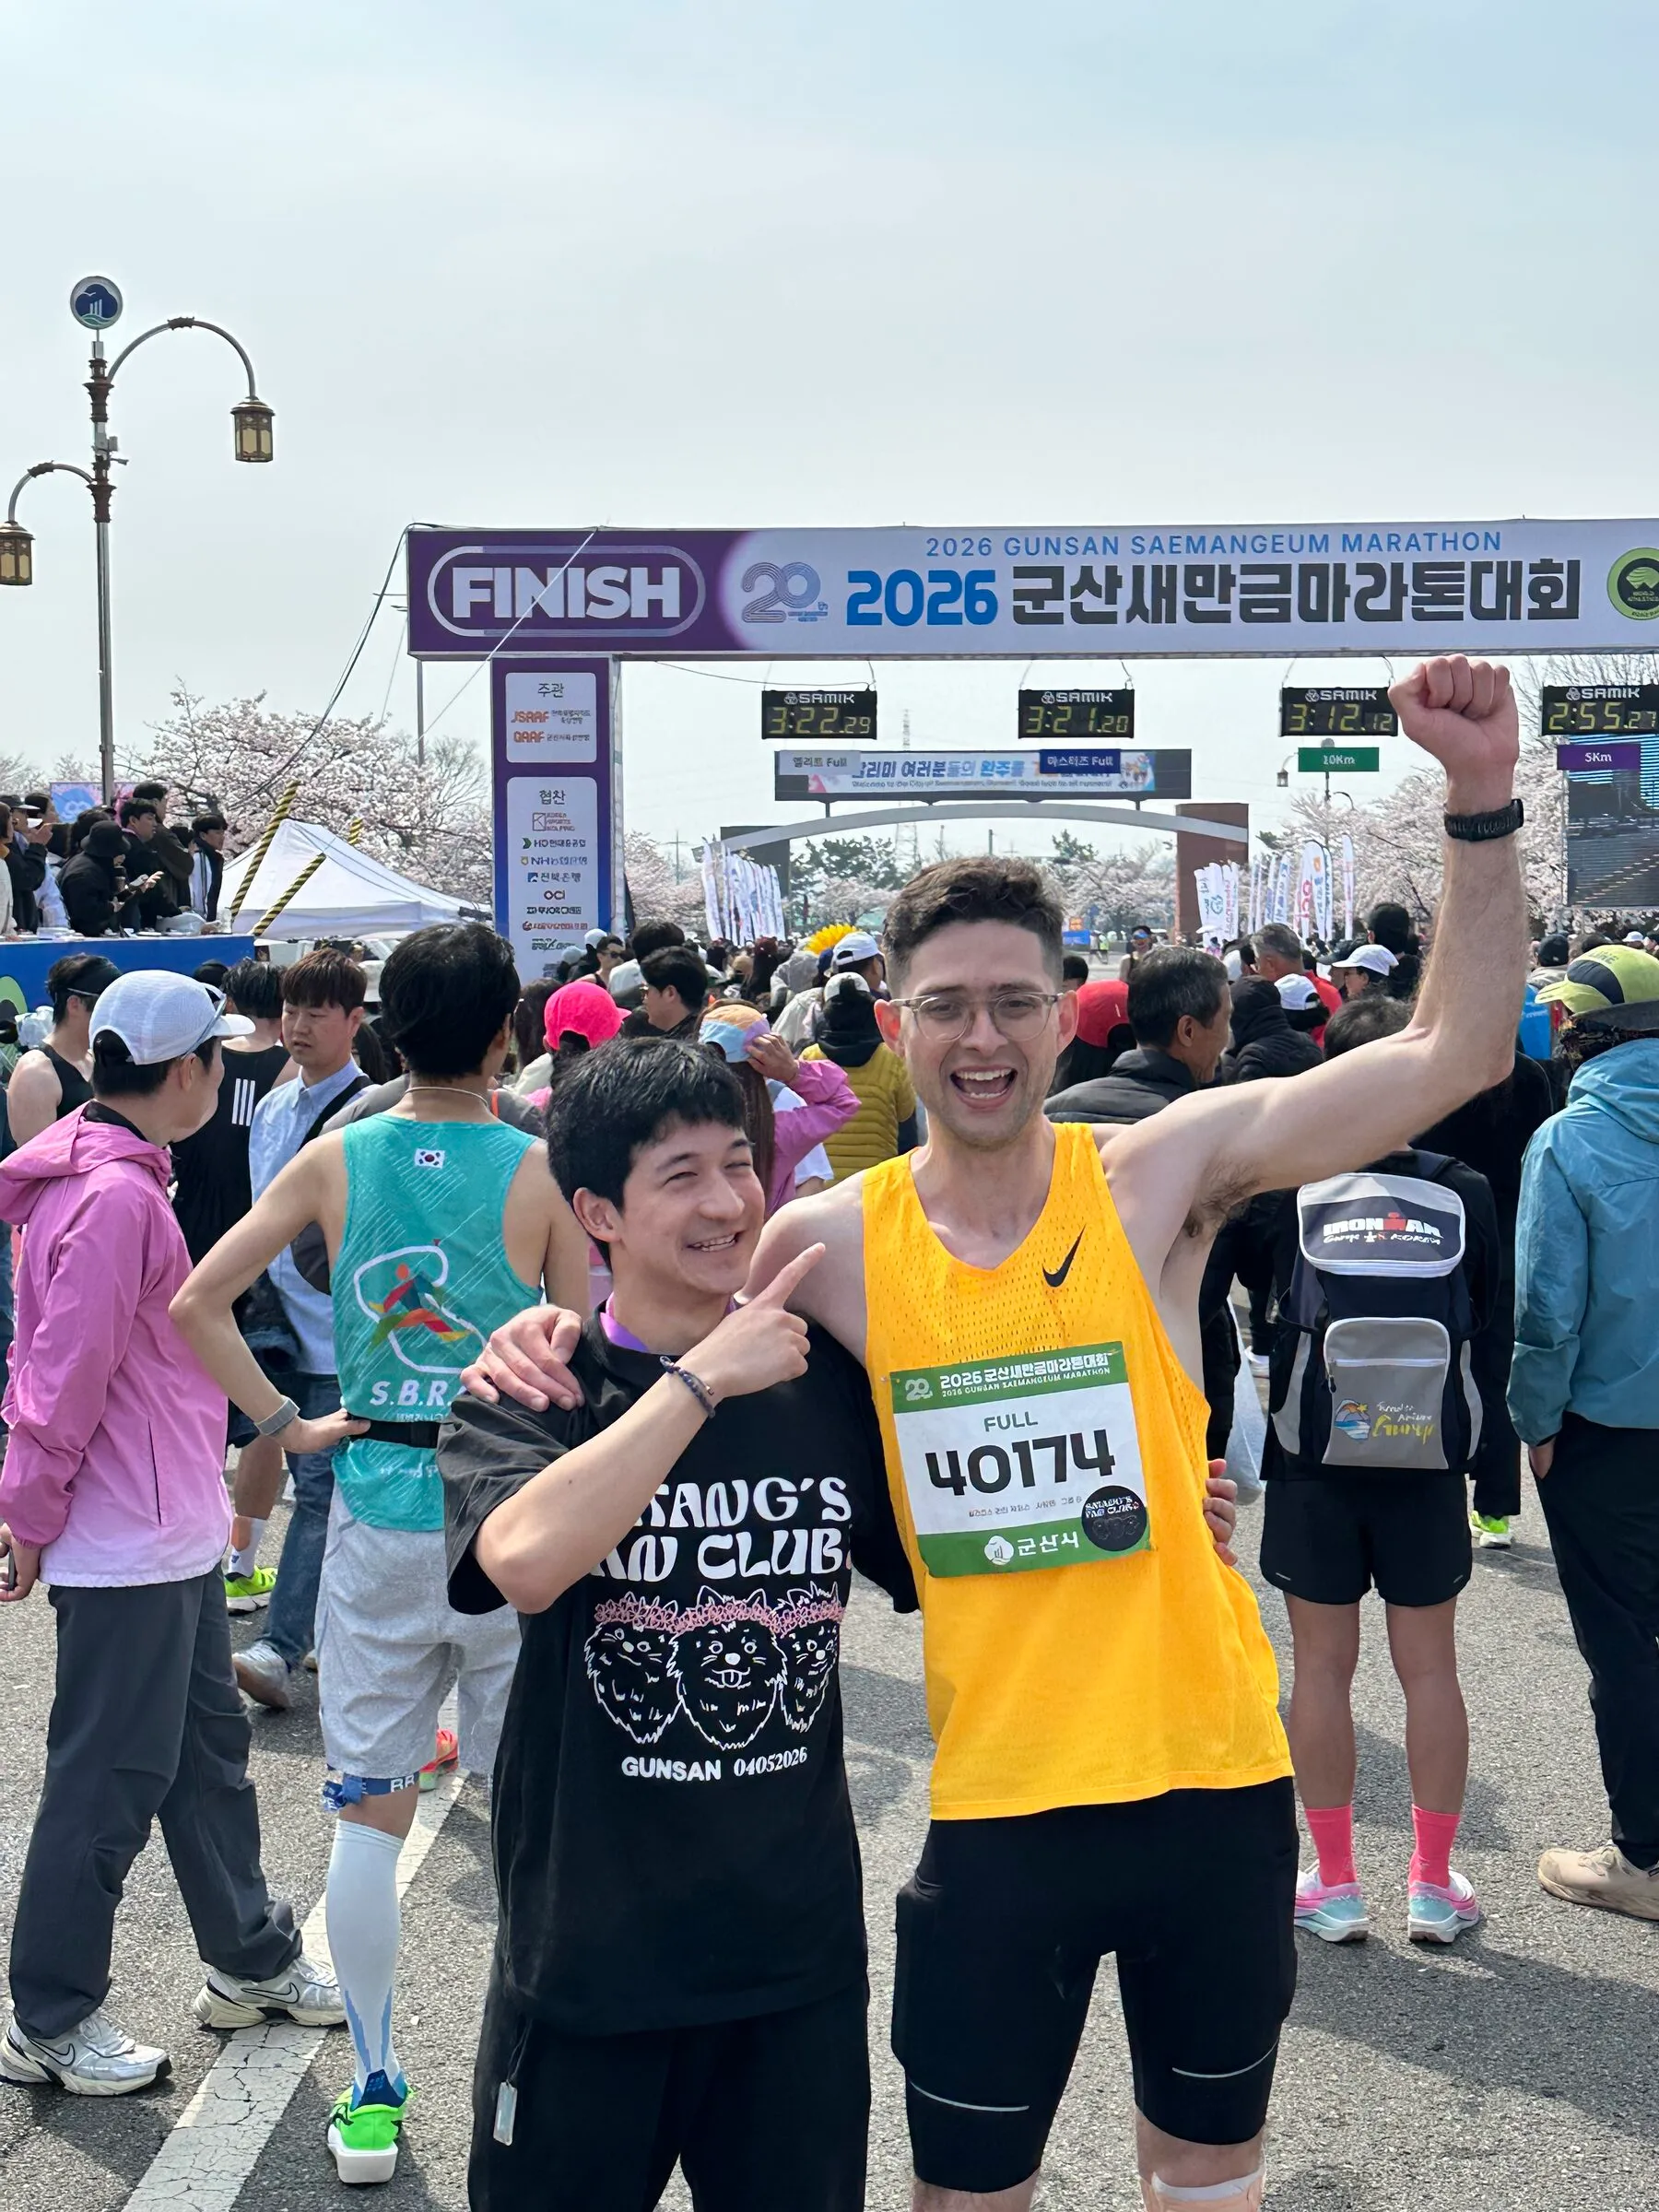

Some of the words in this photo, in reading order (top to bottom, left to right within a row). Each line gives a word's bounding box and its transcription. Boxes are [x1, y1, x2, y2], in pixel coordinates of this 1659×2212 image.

[926, 538, 993, 557] 2026
[1004, 535, 1120, 557] GUNSAN
[1130, 534, 1330, 555] SAEMANGEUM
[1342, 532, 1501, 553] MARATHON
[453, 566, 680, 618] FINISH
[846, 570, 999, 626] 2026
[1012, 559, 1581, 625] 군산새만금마라톤대회
[537, 683, 564, 698] 주관
[798, 692, 855, 704] SAMIK
[1055, 691, 1113, 703] SAMIK
[1320, 689, 1378, 700] SAMIK
[1582, 688, 1641, 700] SAMIK
[1091, 756, 1114, 767] Full
[1323, 755, 1356, 765] 10Km
[539, 789, 567, 805] 협찬
[939, 1370, 983, 1390] 2026
[983, 1352, 1110, 1383] 군산새만금마라톤대회
[1063, 1366, 1112, 1382] MARATHON
[983, 1411, 1039, 1432] FULL
[924, 1429, 1116, 1496] 40174
[1017, 1531, 1080, 1558] 군산시
[697, 1528, 843, 1580] CLUB
[621, 1756, 722, 1782] GUNSAN
[733, 1747, 808, 1777] 04052026
